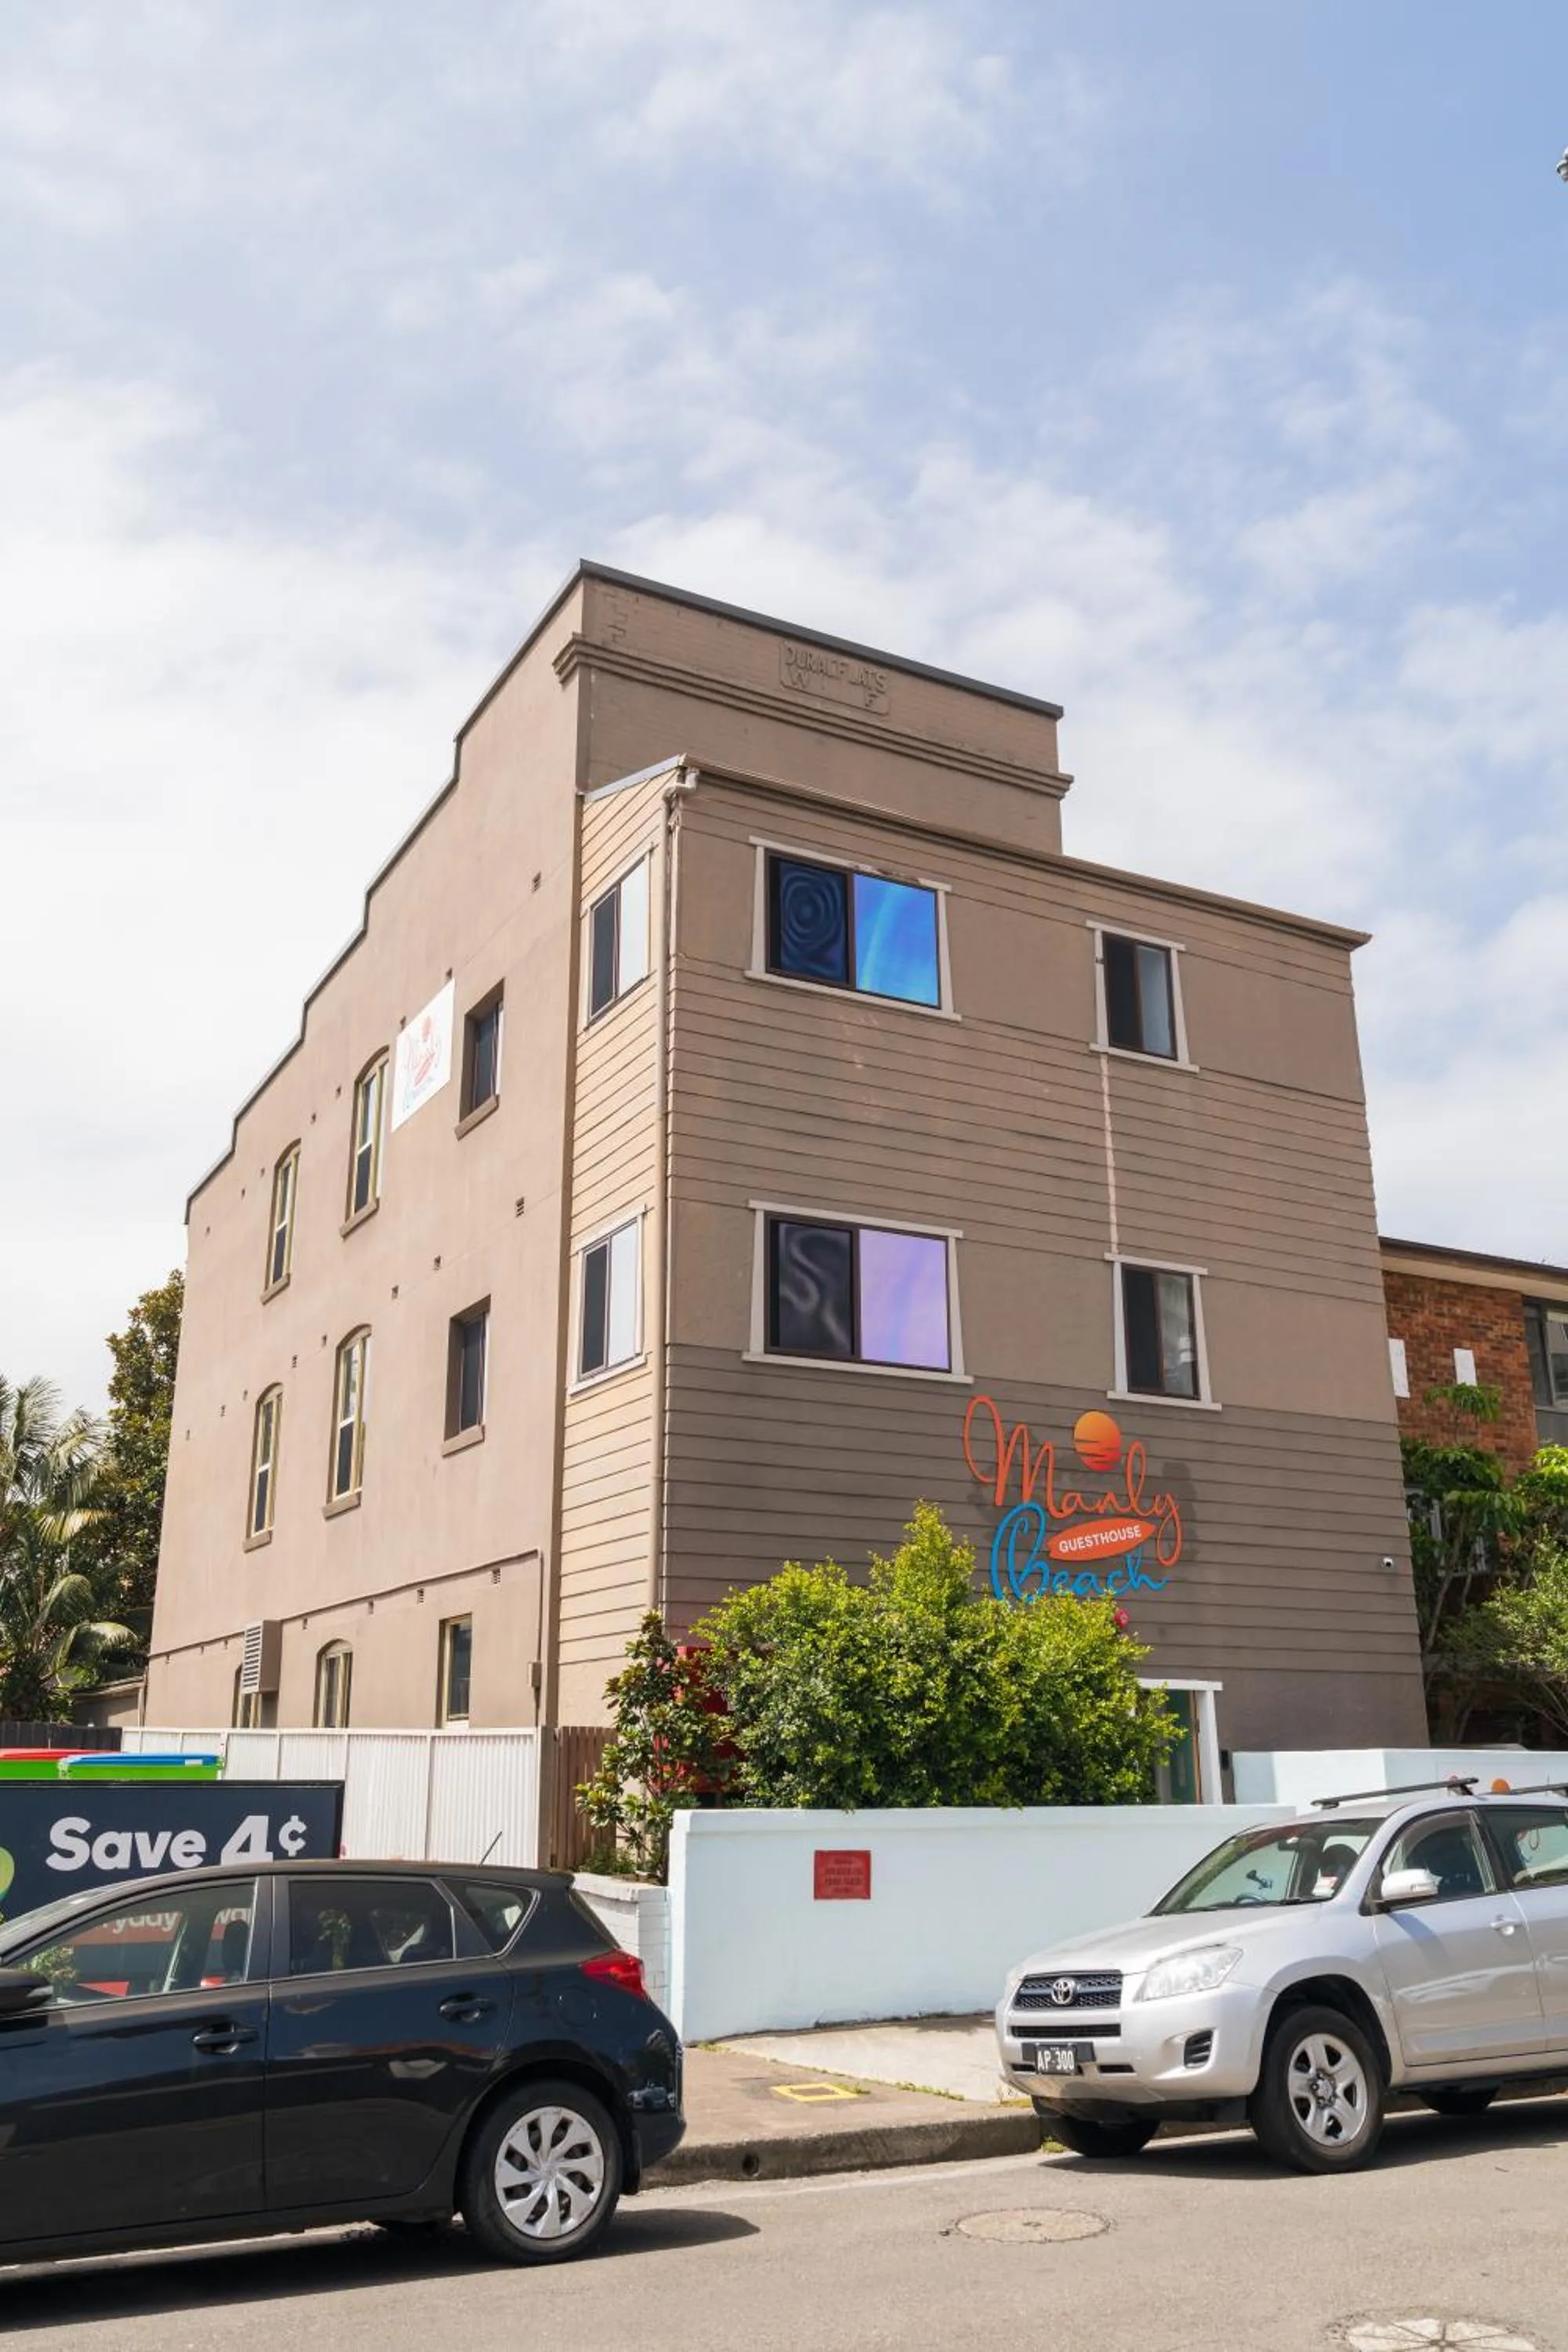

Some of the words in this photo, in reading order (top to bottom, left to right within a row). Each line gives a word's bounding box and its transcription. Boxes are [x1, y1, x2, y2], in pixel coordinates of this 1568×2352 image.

[964, 1395, 1182, 1566] Manly
[990, 1501, 1171, 1603] Beach
[1058, 1524, 1142, 1554] GUESTHOUSE
[45, 1816, 207, 1871] Save
